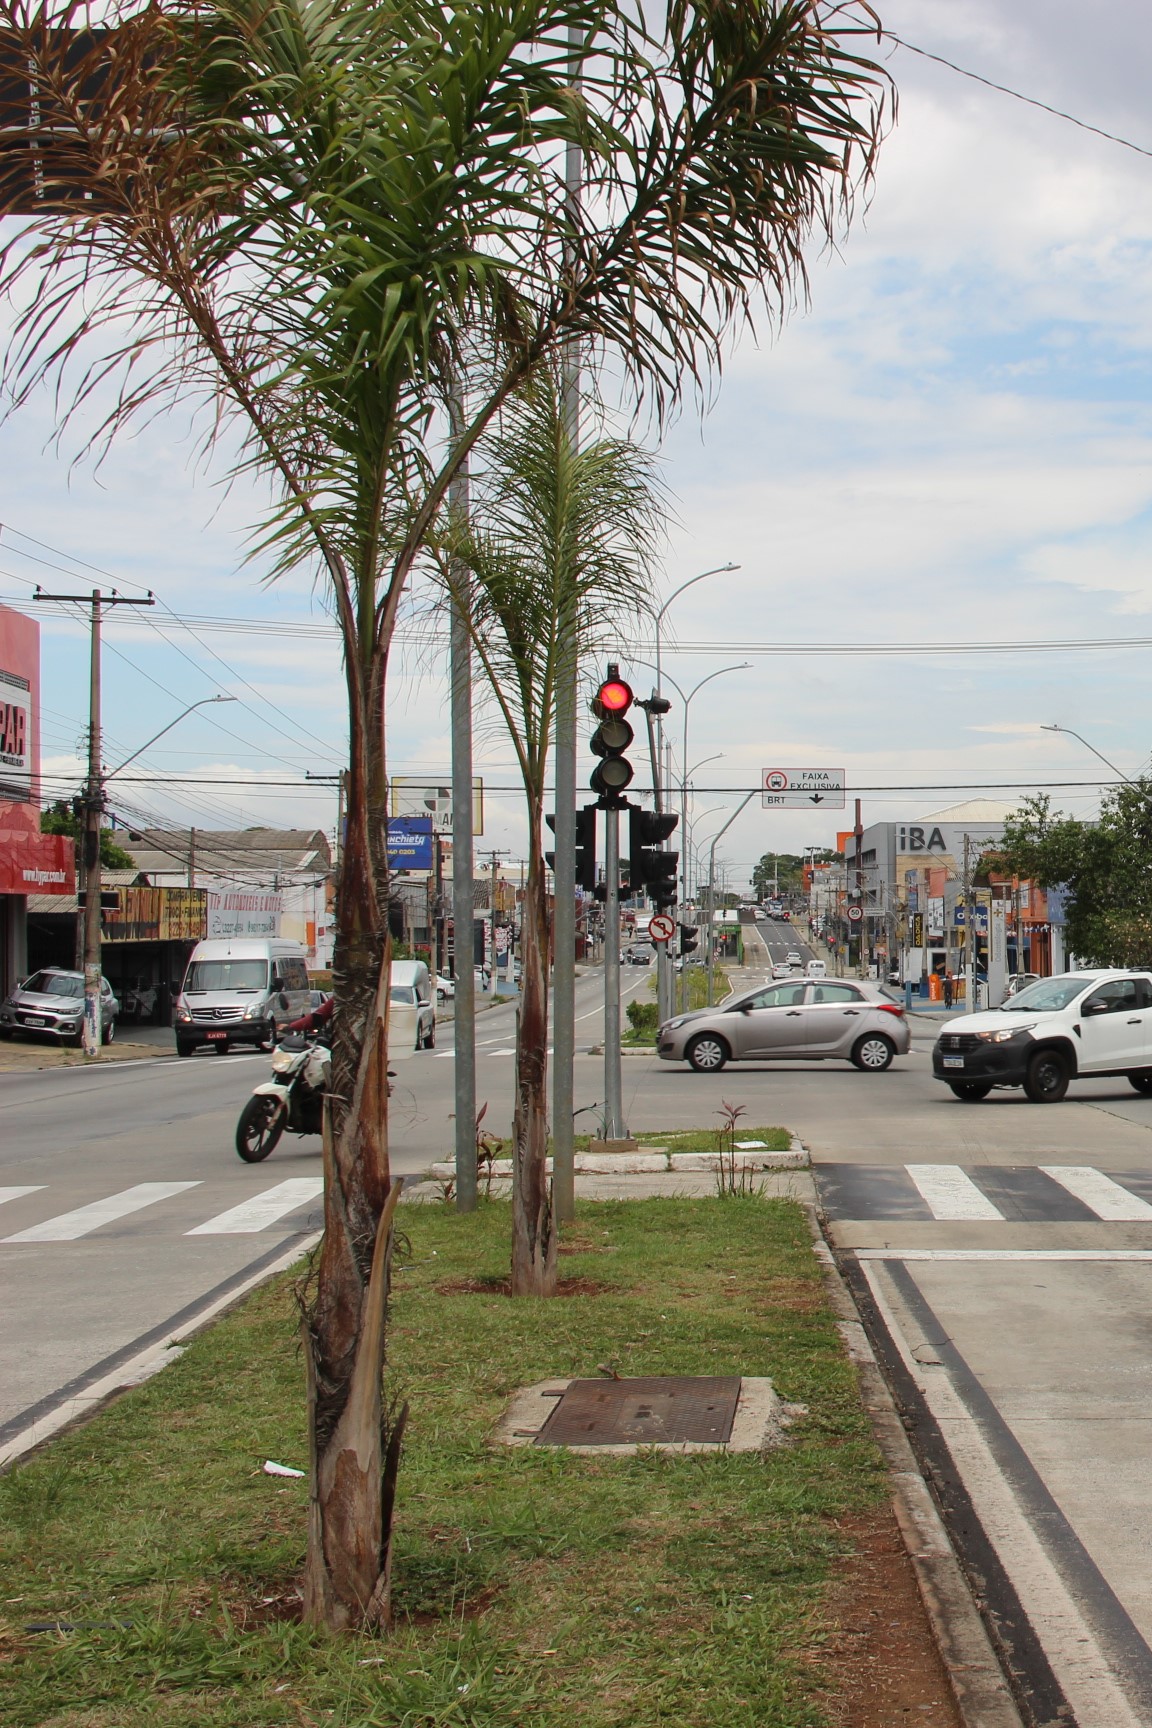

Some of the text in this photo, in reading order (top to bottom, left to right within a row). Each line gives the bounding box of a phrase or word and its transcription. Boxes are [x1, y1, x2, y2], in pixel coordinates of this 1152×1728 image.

[790, 782, 841, 790] EXCLUSIVA
[767, 796, 785, 804] BRT
[900, 827, 947, 850] IBA
